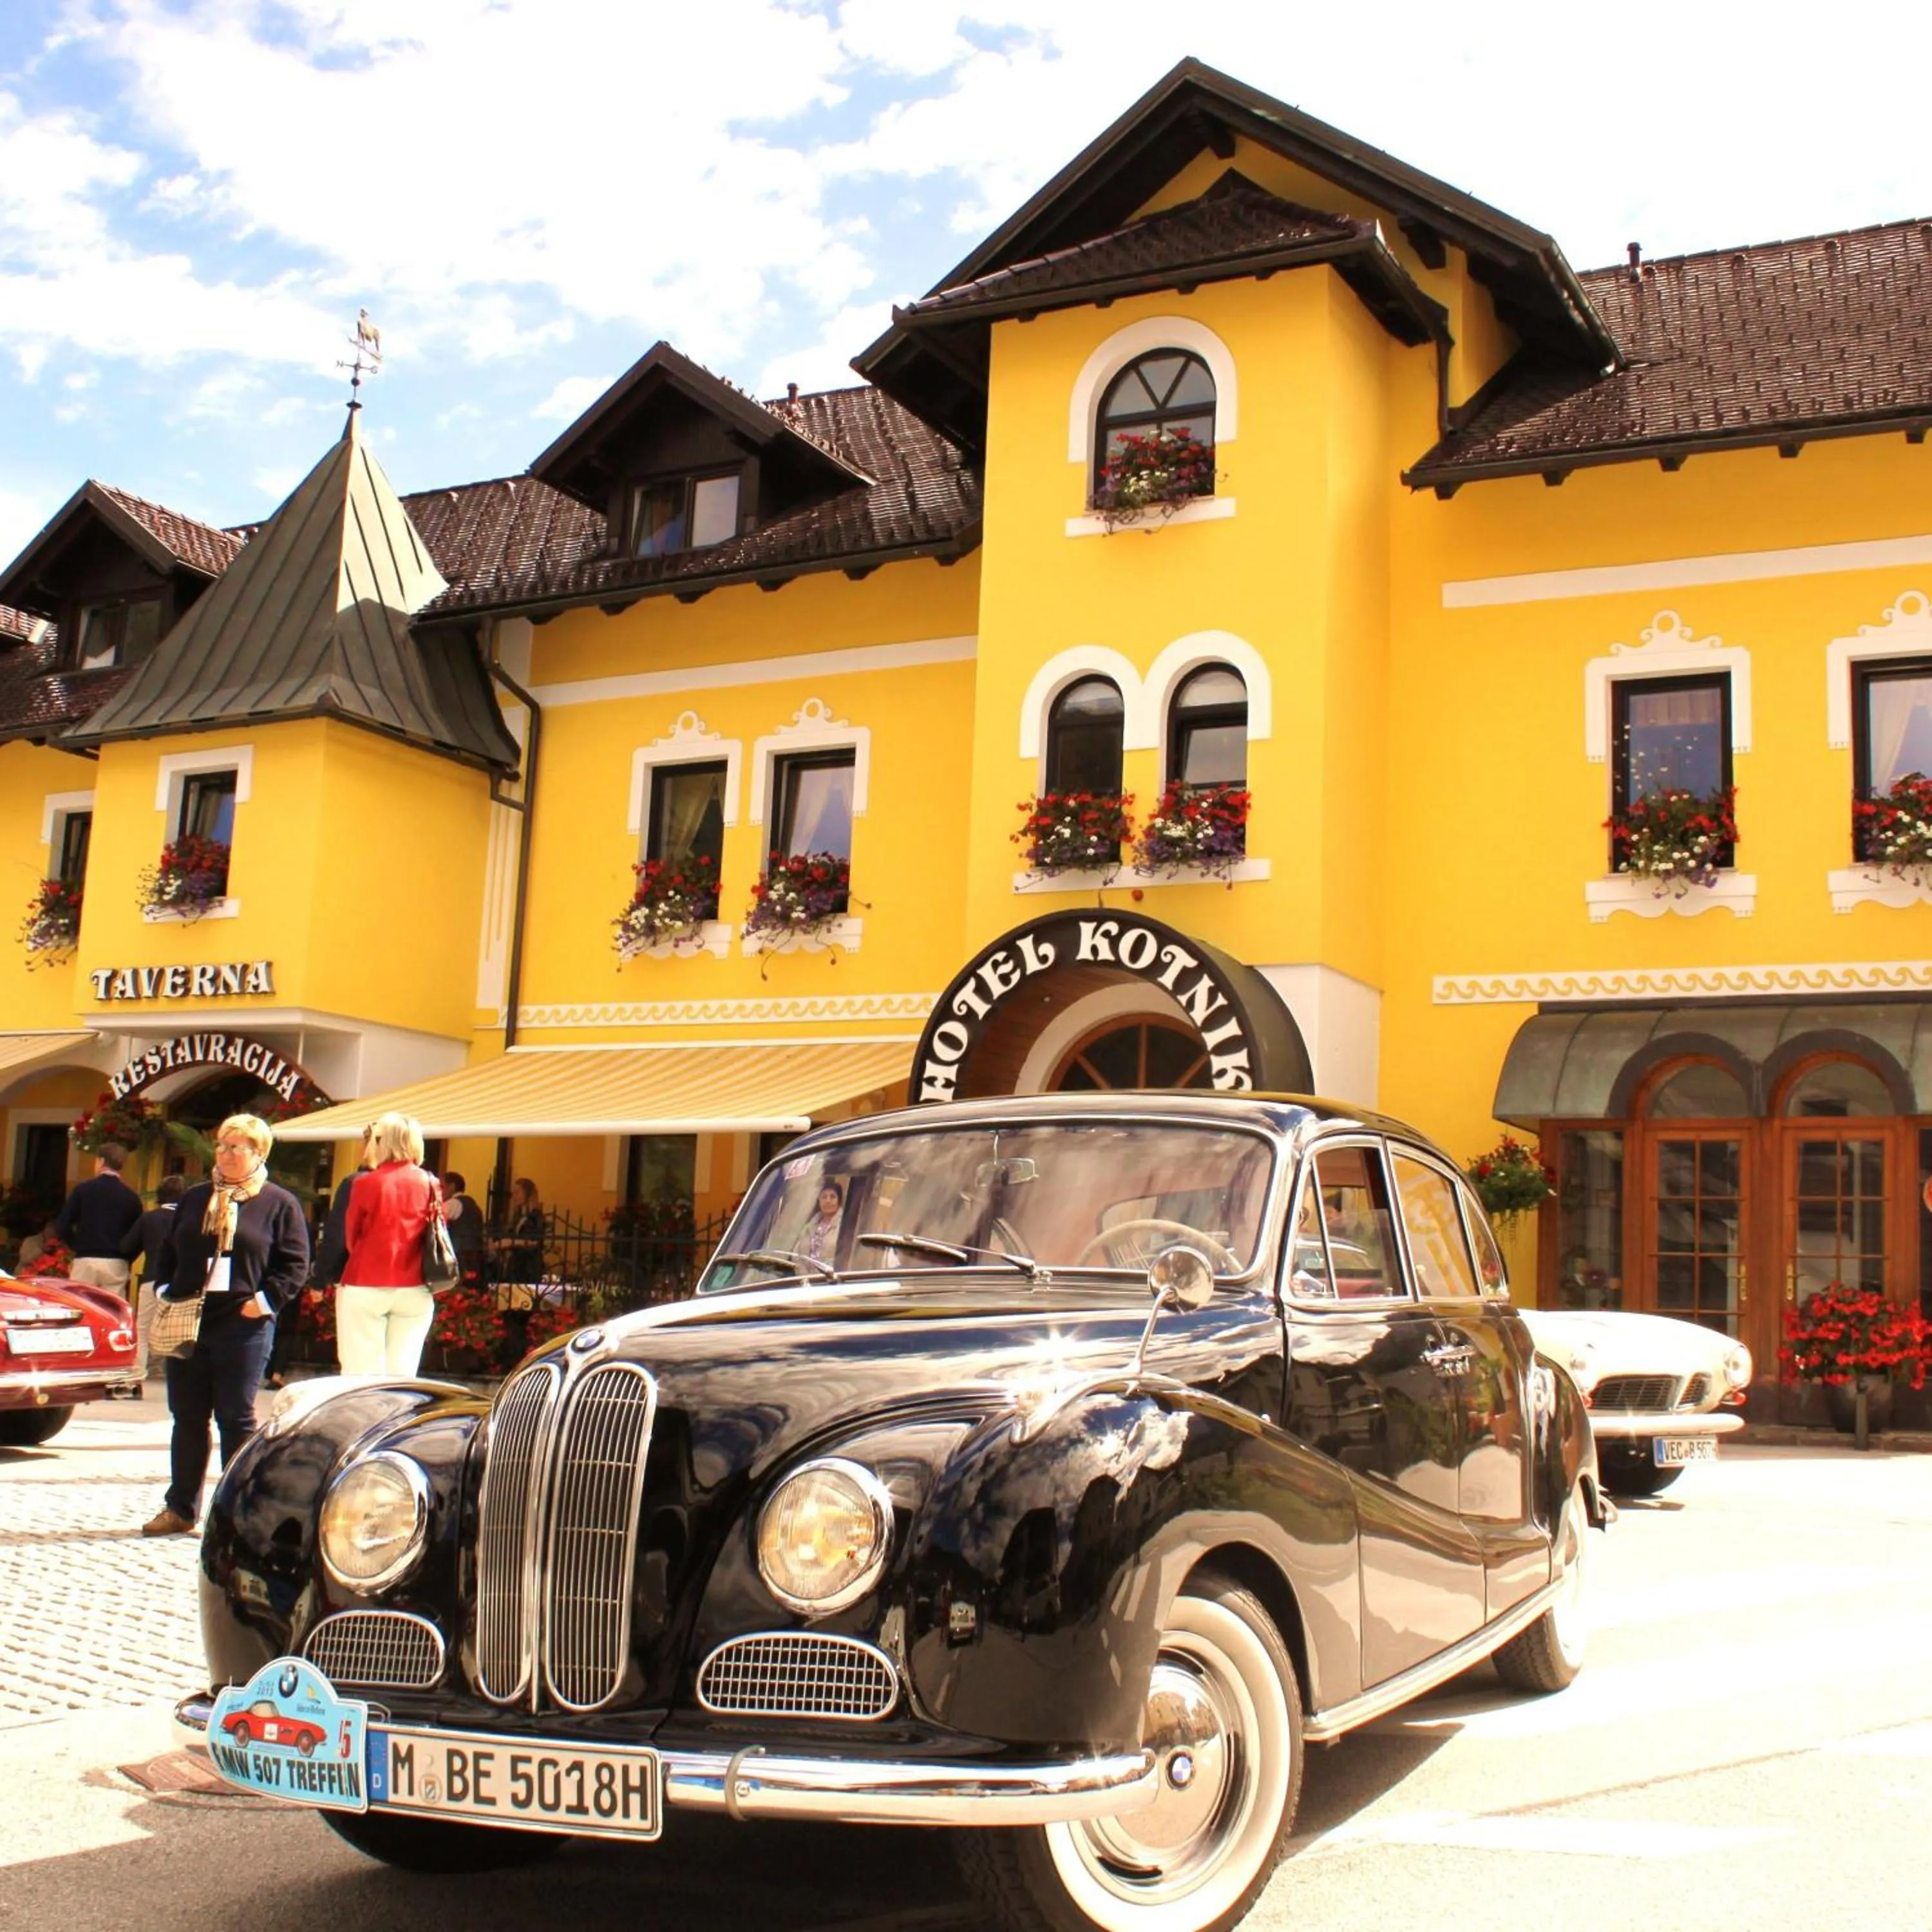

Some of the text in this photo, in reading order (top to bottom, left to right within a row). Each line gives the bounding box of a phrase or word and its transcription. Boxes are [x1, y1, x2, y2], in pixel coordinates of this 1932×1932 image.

[91, 960, 274, 999] TAVERNA
[919, 934, 1055, 1102] HOTEL
[253, 1754, 281, 1786] 507
[373, 1773, 381, 1788] D
[392, 1741, 648, 1821] M BE 5018H
